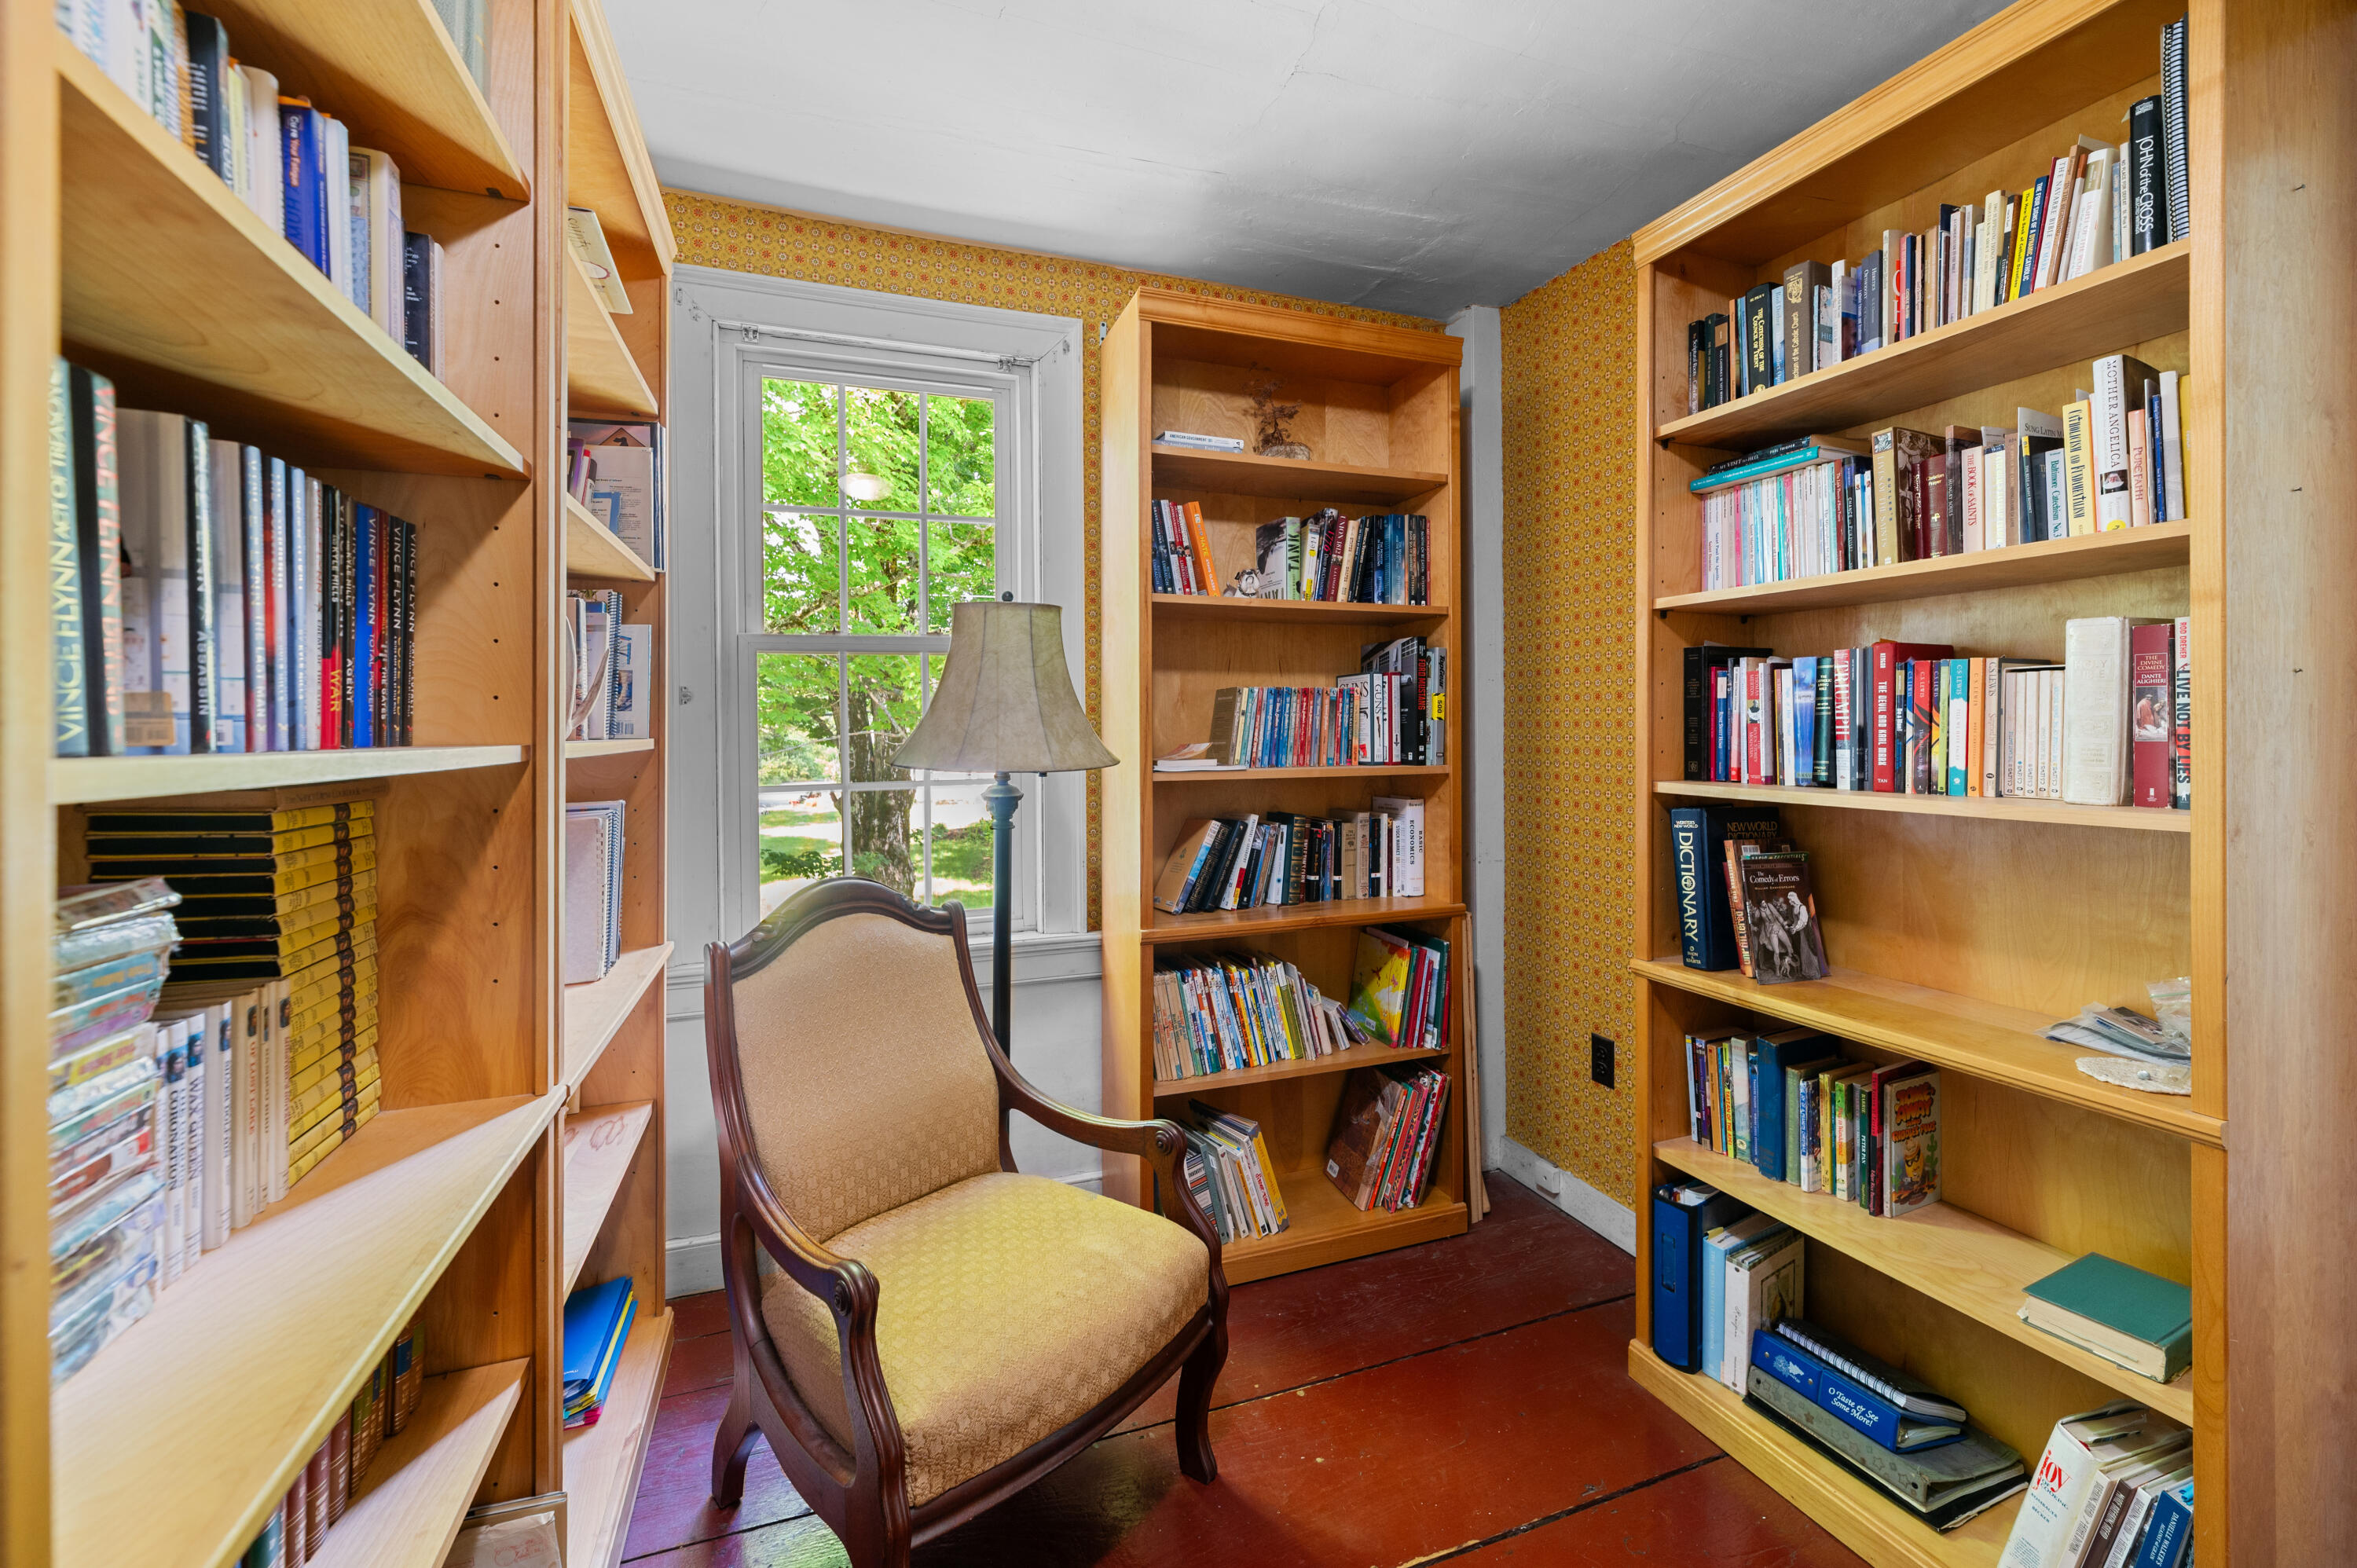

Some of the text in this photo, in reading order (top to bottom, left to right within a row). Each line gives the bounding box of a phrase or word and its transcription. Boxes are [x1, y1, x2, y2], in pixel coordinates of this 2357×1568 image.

[289, 157, 299, 186] Fatigue
[2135, 135, 2154, 233] JOHN CROSS
[2031, 207, 2040, 222] SIGNS
[2033, 192, 2042, 206] FOUR
[2047, 161, 2066, 238] THE NAVARRE BIBLE
[2025, 234, 2036, 257] DYNAMIC
[2022, 257, 2033, 281] CATHOLIC
[2025, 423, 2056, 437] SUNG LATIN
[2106, 359, 2121, 468] MOTHER ANGELICA
[1967, 467, 1976, 489] BOOK
[2051, 460, 2059, 489] Baltimore
[2069, 409, 2085, 518] CATHOLICISM FUNDAMENTALISM
[94, 387, 121, 606] VINCE FLYNN
[1967, 497, 1978, 526] SAINTS
[2051, 490, 2061, 521] Catechism
[1323, 530, 1335, 555] 1776
[1337, 515, 1347, 539] UNION
[2053, 522, 2062, 532] No.
[1200, 537, 1208, 557] NATE
[1288, 534, 1300, 572] TANK
[49, 540, 84, 742] VINCE FLYNN
[197, 631, 209, 716] ASSASSIN
[255, 614, 265, 718] THE LAST MAN
[330, 669, 342, 713] WAR
[1417, 660, 1426, 710] FORD MUSTANG
[1835, 660, 1850, 735] TRIUMPH
[1989, 672, 1997, 697] LEWIS
[1878, 681, 1887, 766] THE DEVIL AND KARL MARX
[2176, 670, 2190, 784] LIVE NOT BY LIES
[1727, 822, 1777, 831] NEW WORLD
[1678, 832, 1699, 943] DICTIONARY
[1750, 875, 1774, 884] Comedy
[248, 1041, 257, 1135] OF LOST LAKE
[1896, 1097, 1934, 1126] AWAY
[169, 1090, 180, 1192] CORONATION
[188, 1077, 199, 1181] WAX QUEEN
[1828, 1387, 1879, 1423] O Taste See
[1831, 1396, 1873, 1426] Some More!
[2040, 1480, 2069, 1510] COOKING
[2032, 1506, 2050, 1524] BECKER
[2150, 1522, 2166, 1561] AGAINST GRAIN
[2155, 1511, 2179, 1566] DANIELLE WALKER'S
